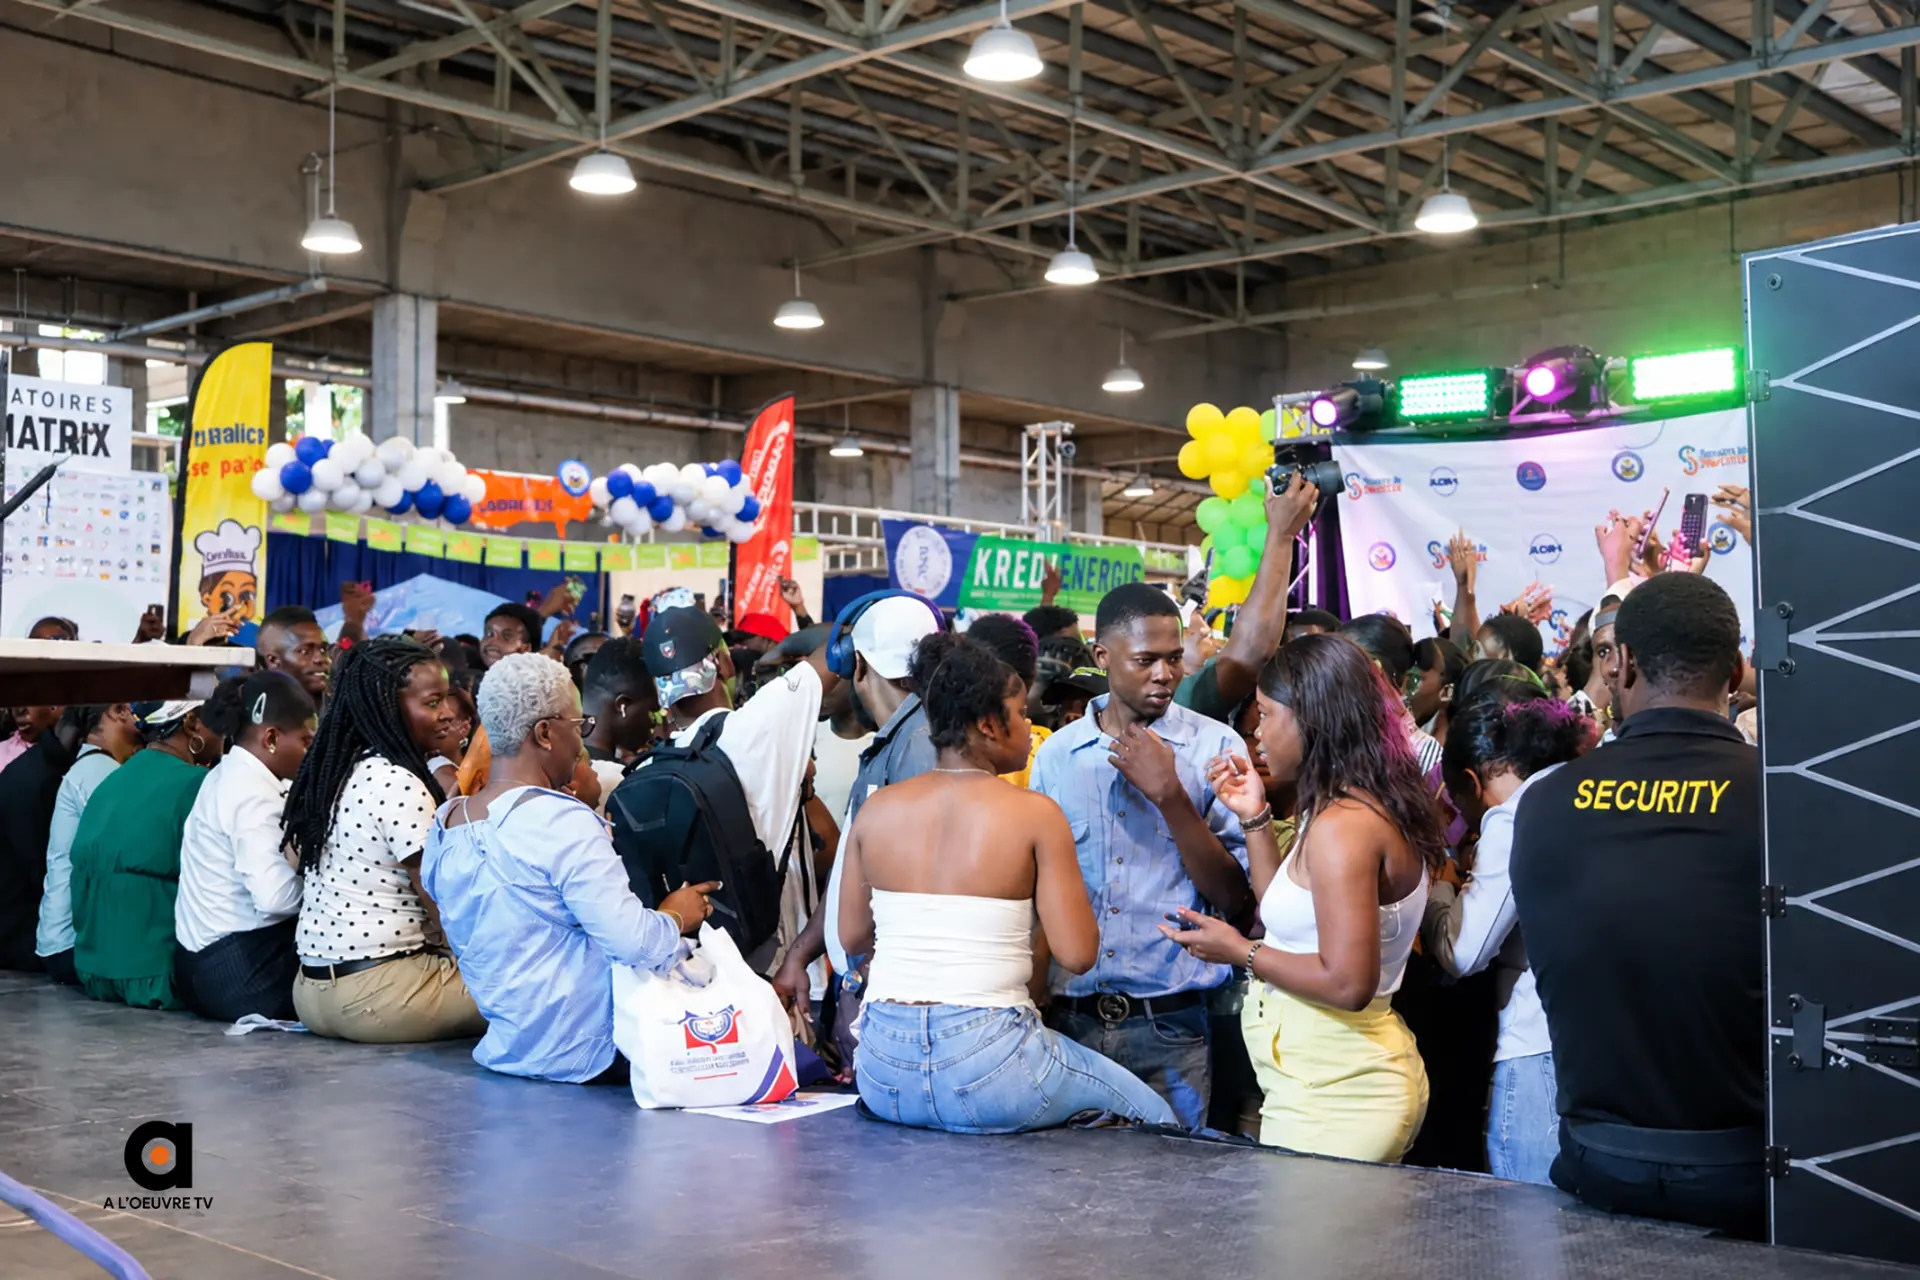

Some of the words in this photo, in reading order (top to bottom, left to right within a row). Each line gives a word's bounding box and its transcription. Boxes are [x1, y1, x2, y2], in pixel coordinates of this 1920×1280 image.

[11, 387, 112, 415] ATOIRES
[1061, 553, 1142, 593] ENERGIE
[1573, 779, 1731, 814] SECURITY
